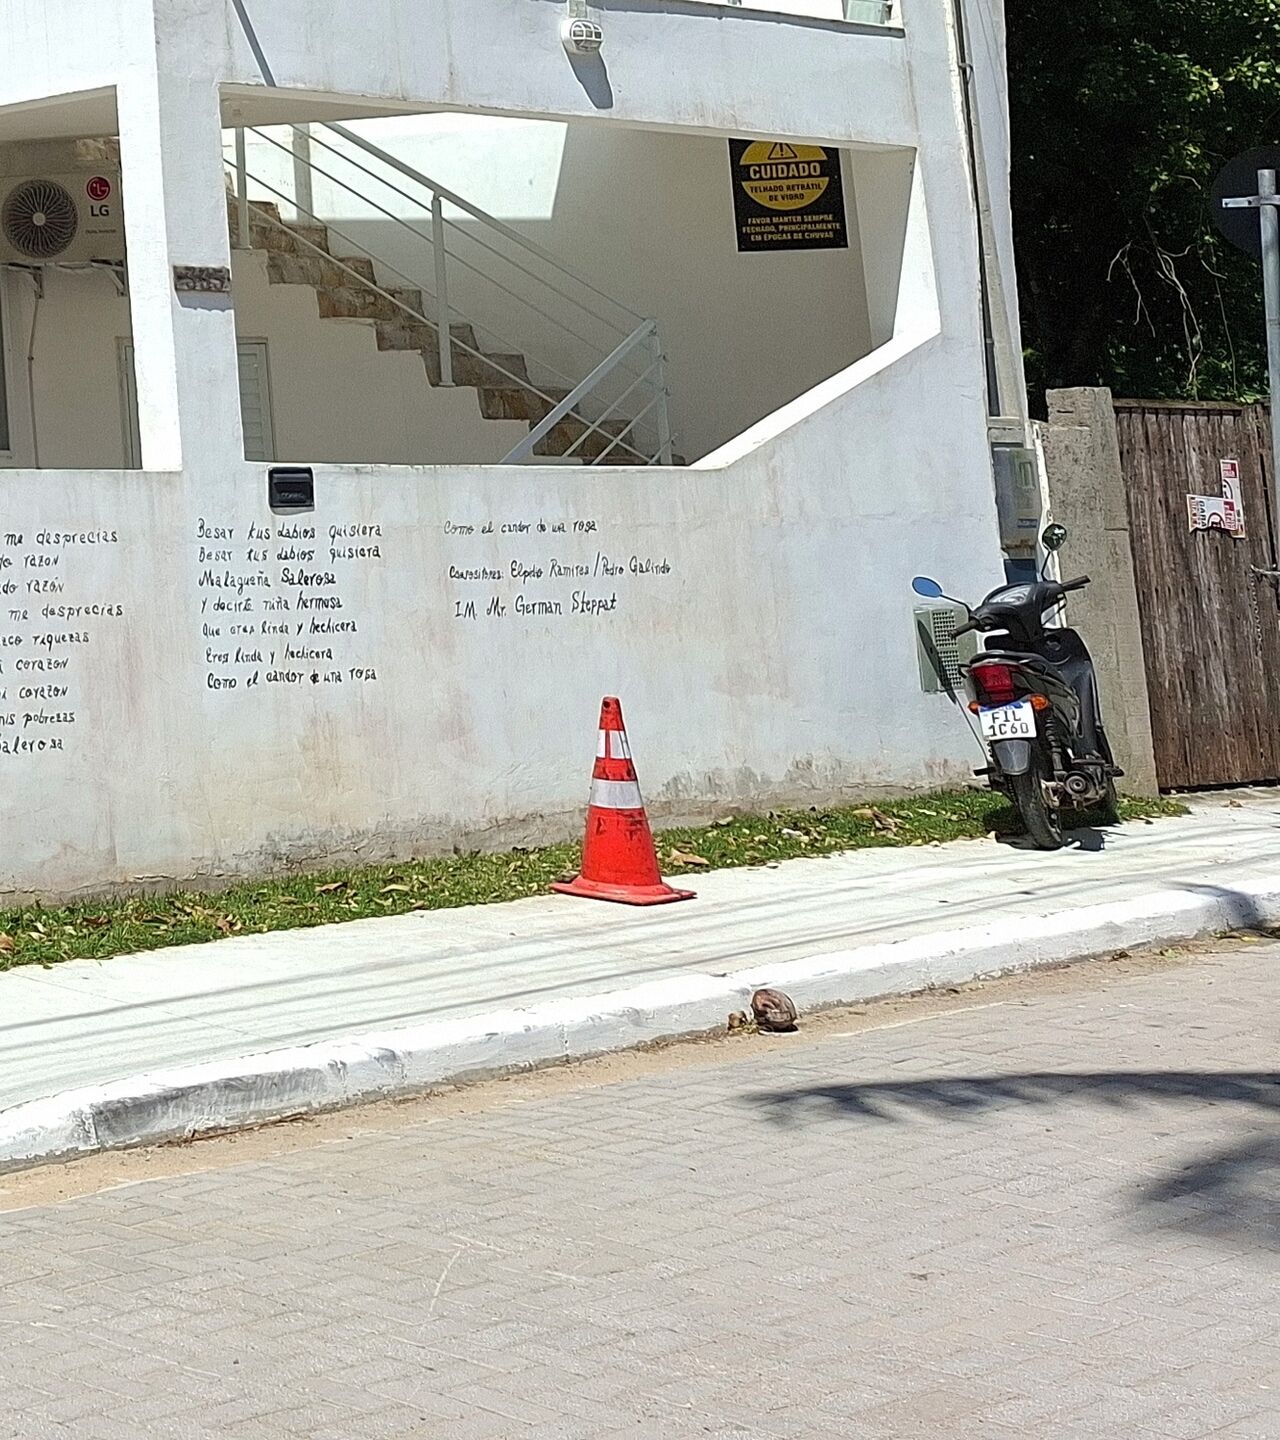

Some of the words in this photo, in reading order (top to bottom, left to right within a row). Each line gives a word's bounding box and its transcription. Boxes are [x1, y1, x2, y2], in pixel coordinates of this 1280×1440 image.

[750, 162, 820, 179] CUIDADO
[91, 205, 109, 217] LG
[197, 518, 234, 539] Besar
[515, 595, 562, 616] German
[8, 608, 28, 621] me
[247, 671, 258, 687] el
[992, 711, 1021, 723] FIL
